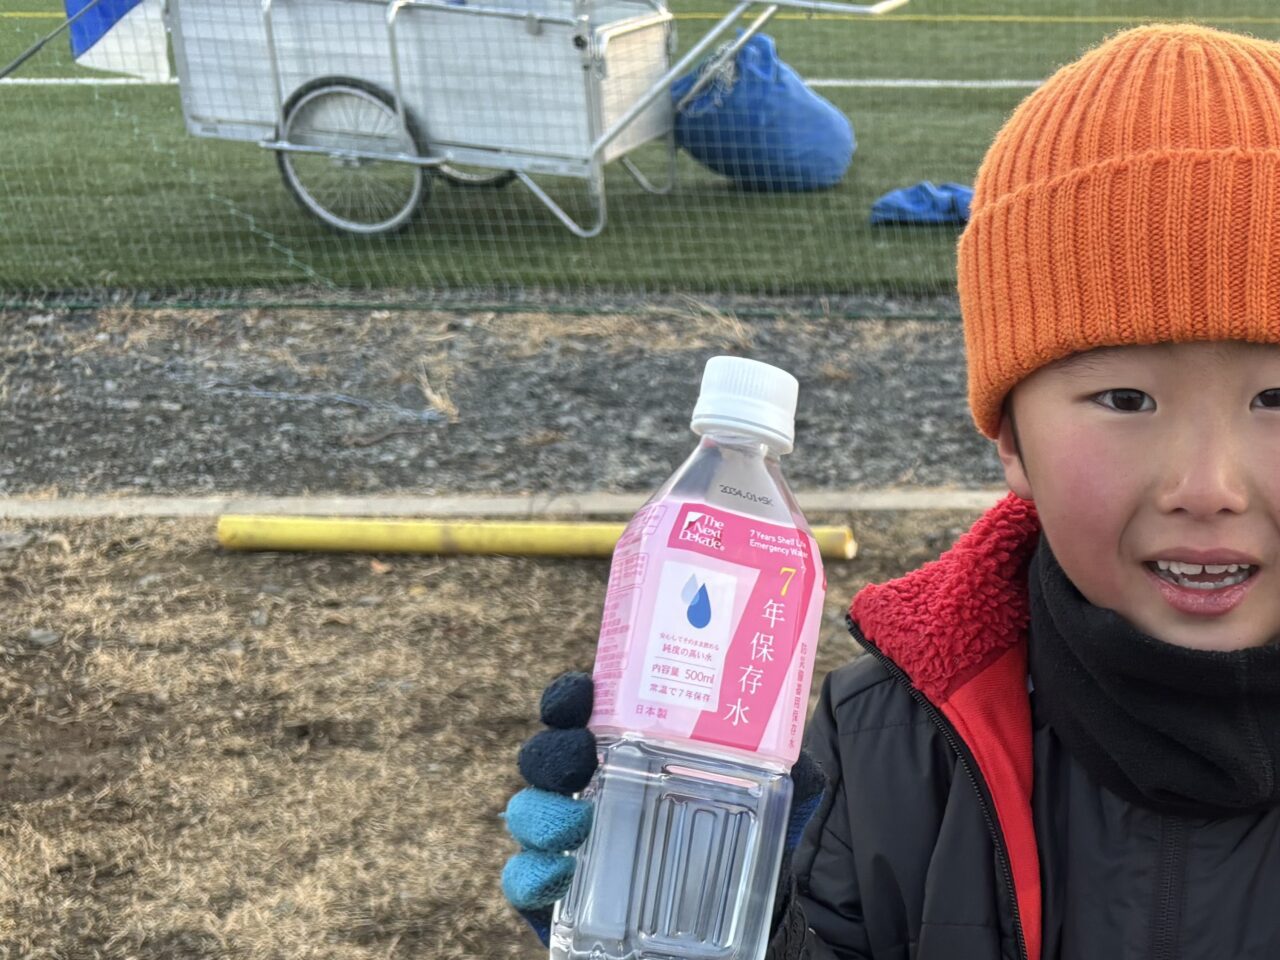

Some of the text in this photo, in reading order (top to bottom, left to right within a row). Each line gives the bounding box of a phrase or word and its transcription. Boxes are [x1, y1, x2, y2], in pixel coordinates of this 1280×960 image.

[703, 514, 724, 529] The
[694, 521, 721, 539] Next
[750, 529, 756, 538] 7
[756, 530, 776, 543] Years
[749, 538, 789, 557] Emergency
[684, 670, 715, 685] 500ml
[635, 704, 668, 719] 日本製
